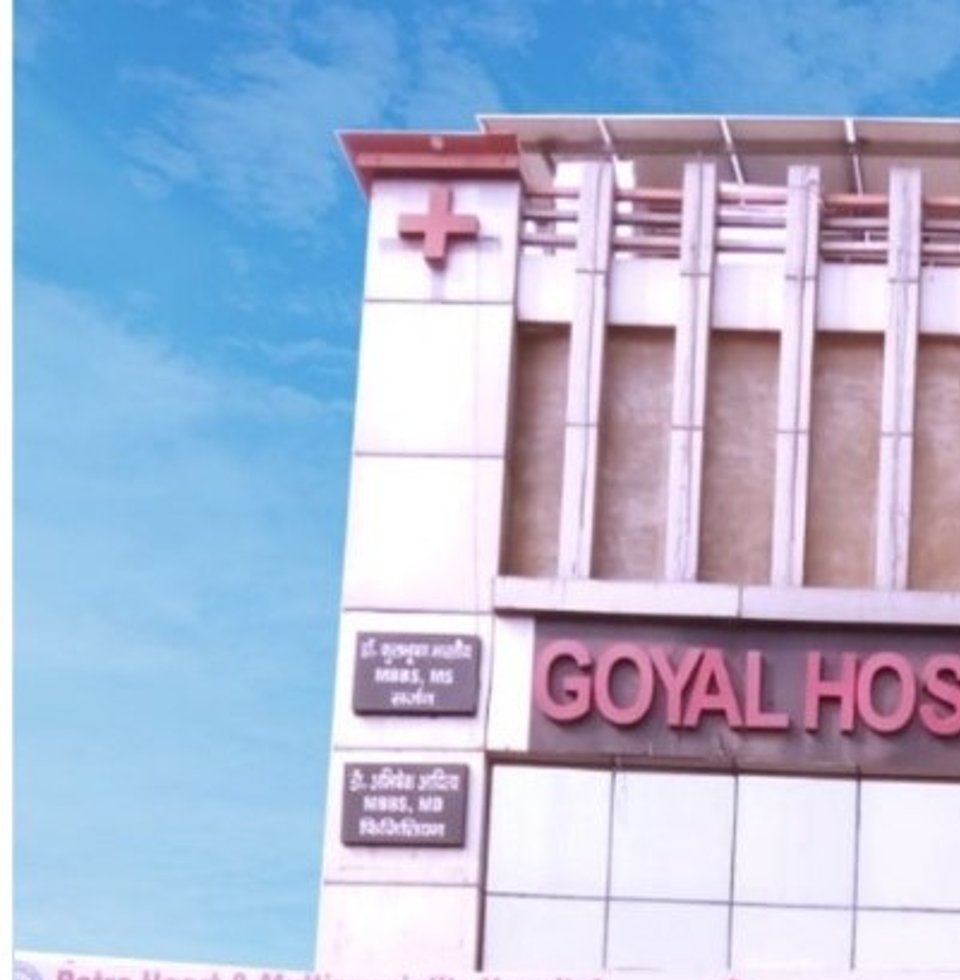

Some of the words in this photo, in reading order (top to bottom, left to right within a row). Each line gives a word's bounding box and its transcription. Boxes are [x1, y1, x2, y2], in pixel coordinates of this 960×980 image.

[429, 668, 454, 685] MS
[533, 639, 790, 730] GOYAL
[418, 796, 444, 812] MD
